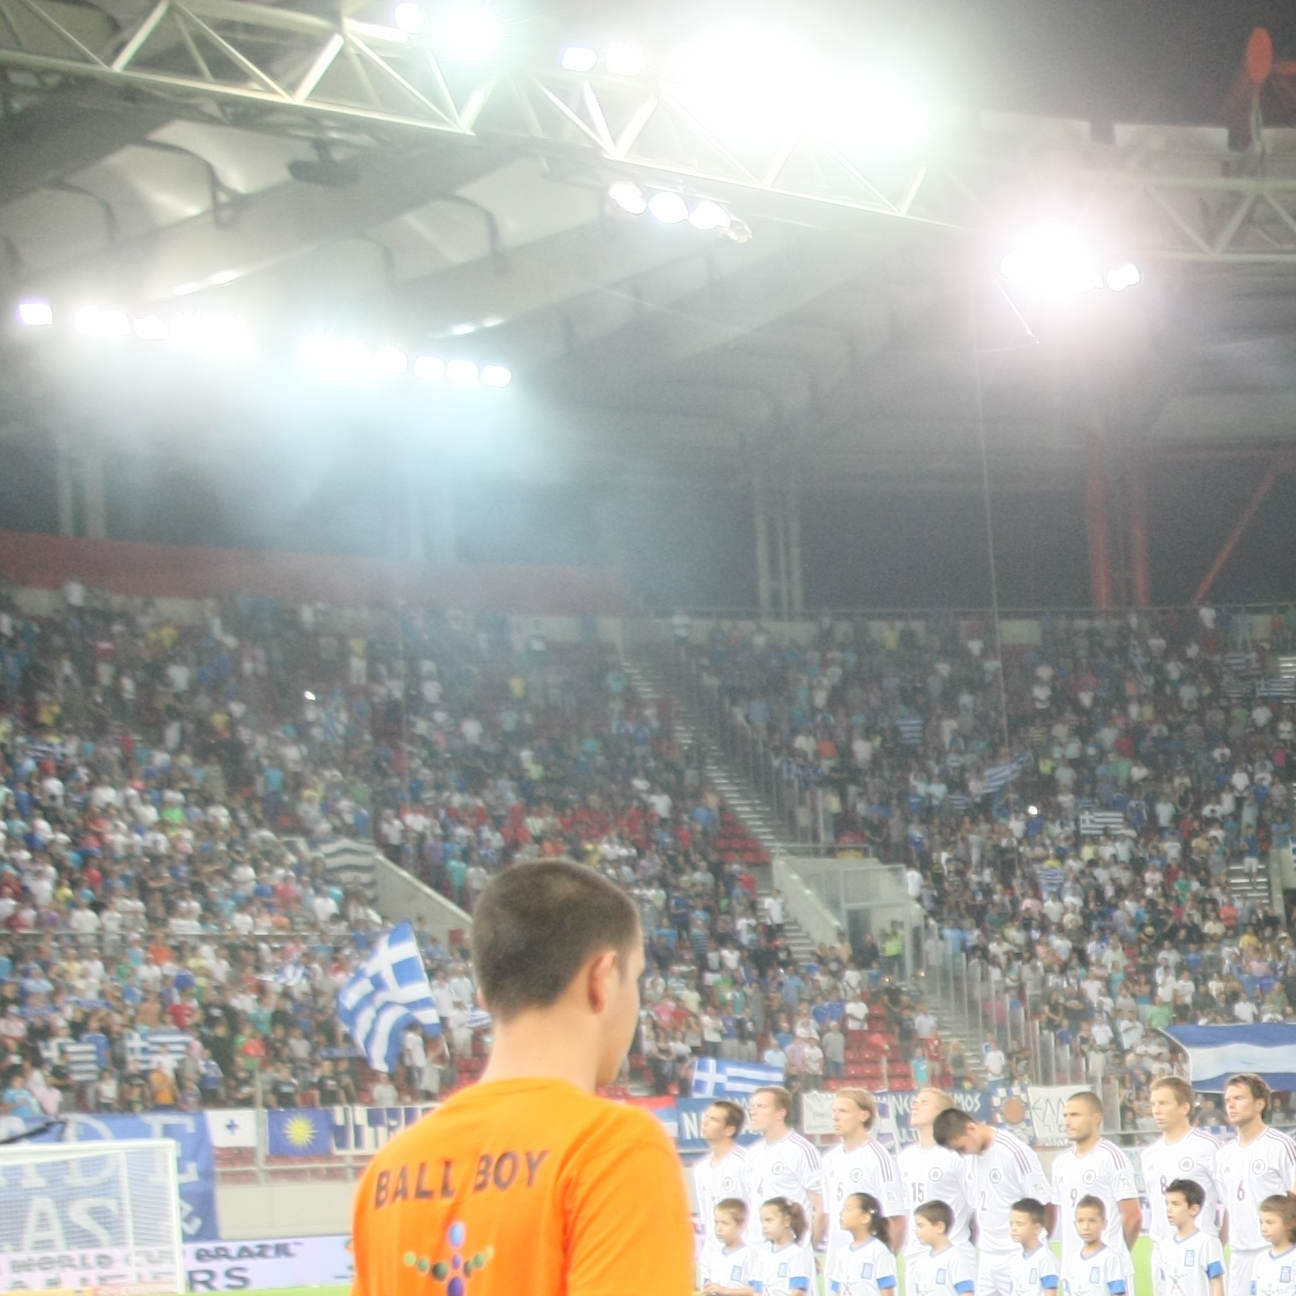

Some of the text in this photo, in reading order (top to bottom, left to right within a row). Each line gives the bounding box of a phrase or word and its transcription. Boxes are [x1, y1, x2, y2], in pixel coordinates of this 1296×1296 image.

[375, 1149, 550, 1208] BALL BOY
[911, 1183, 924, 1203] 15
[1237, 1180, 1245, 1201] 6
